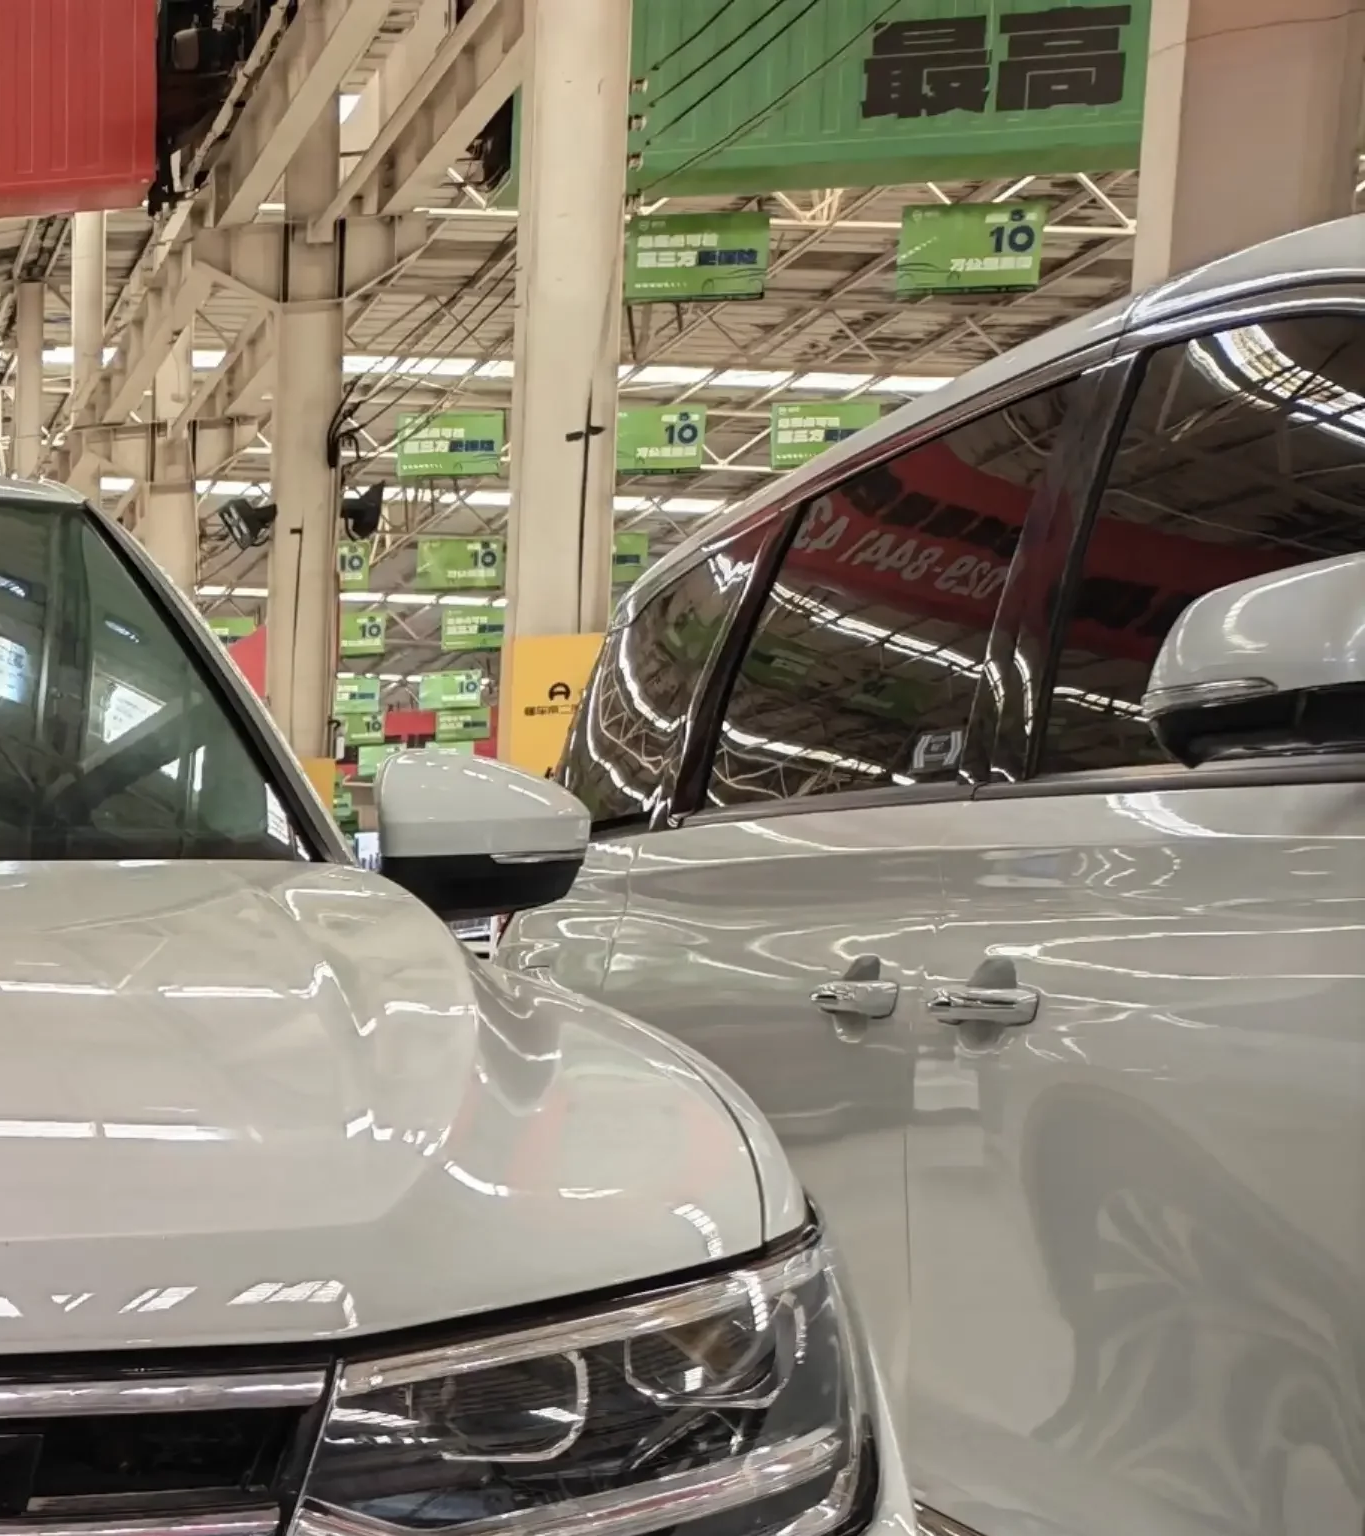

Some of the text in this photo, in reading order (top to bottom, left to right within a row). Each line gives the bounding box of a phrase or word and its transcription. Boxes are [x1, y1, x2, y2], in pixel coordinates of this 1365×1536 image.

[860, 4, 1132, 119] 最高
[990, 225, 1036, 253] 10
[664, 423, 698, 447] 10
[472, 550, 497, 567] 10
